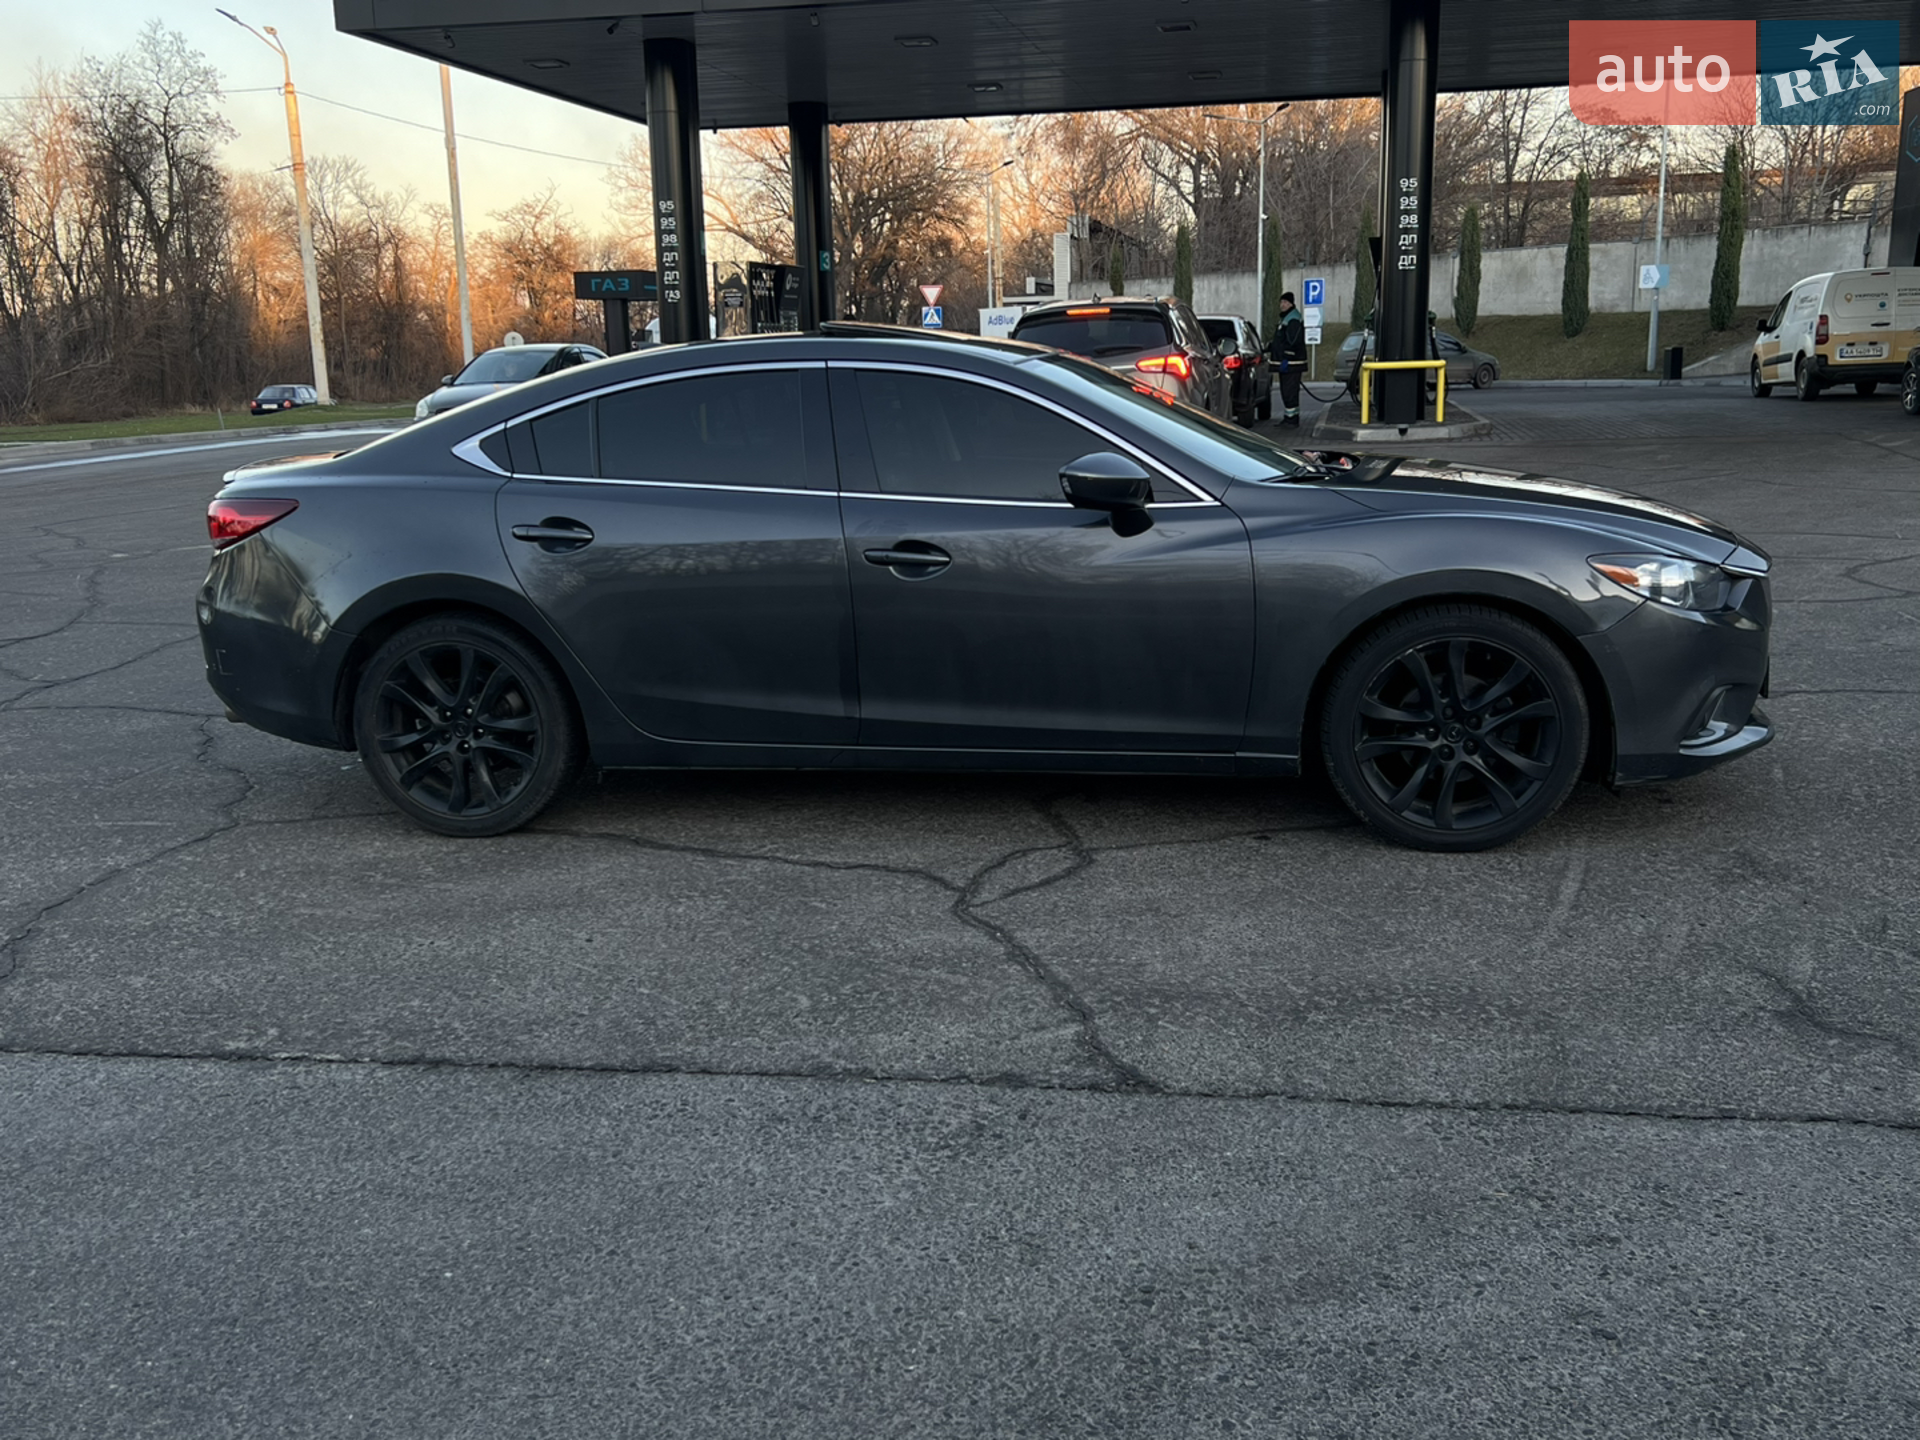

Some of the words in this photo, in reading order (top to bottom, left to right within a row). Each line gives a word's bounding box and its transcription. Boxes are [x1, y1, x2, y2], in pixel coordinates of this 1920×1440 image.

[1400, 178, 1418, 188] 95
[659, 201, 675, 210] 95
[1400, 196, 1418, 206] 95
[660, 217, 676, 226] 95
[1400, 214, 1418, 224] 98
[662, 234, 678, 243] 98
[1399, 234, 1418, 246] ДП
[663, 252, 679, 262] ДП
[823, 252, 831, 270] 3
[1398, 255, 1417, 266] ДП
[664, 271, 680, 281] ДП
[591, 277, 630, 292] ГАЗ
[665, 290, 681, 299] ГАЗ
[1309, 281, 1321, 303] P
[988, 314, 1015, 326] AdBlue
